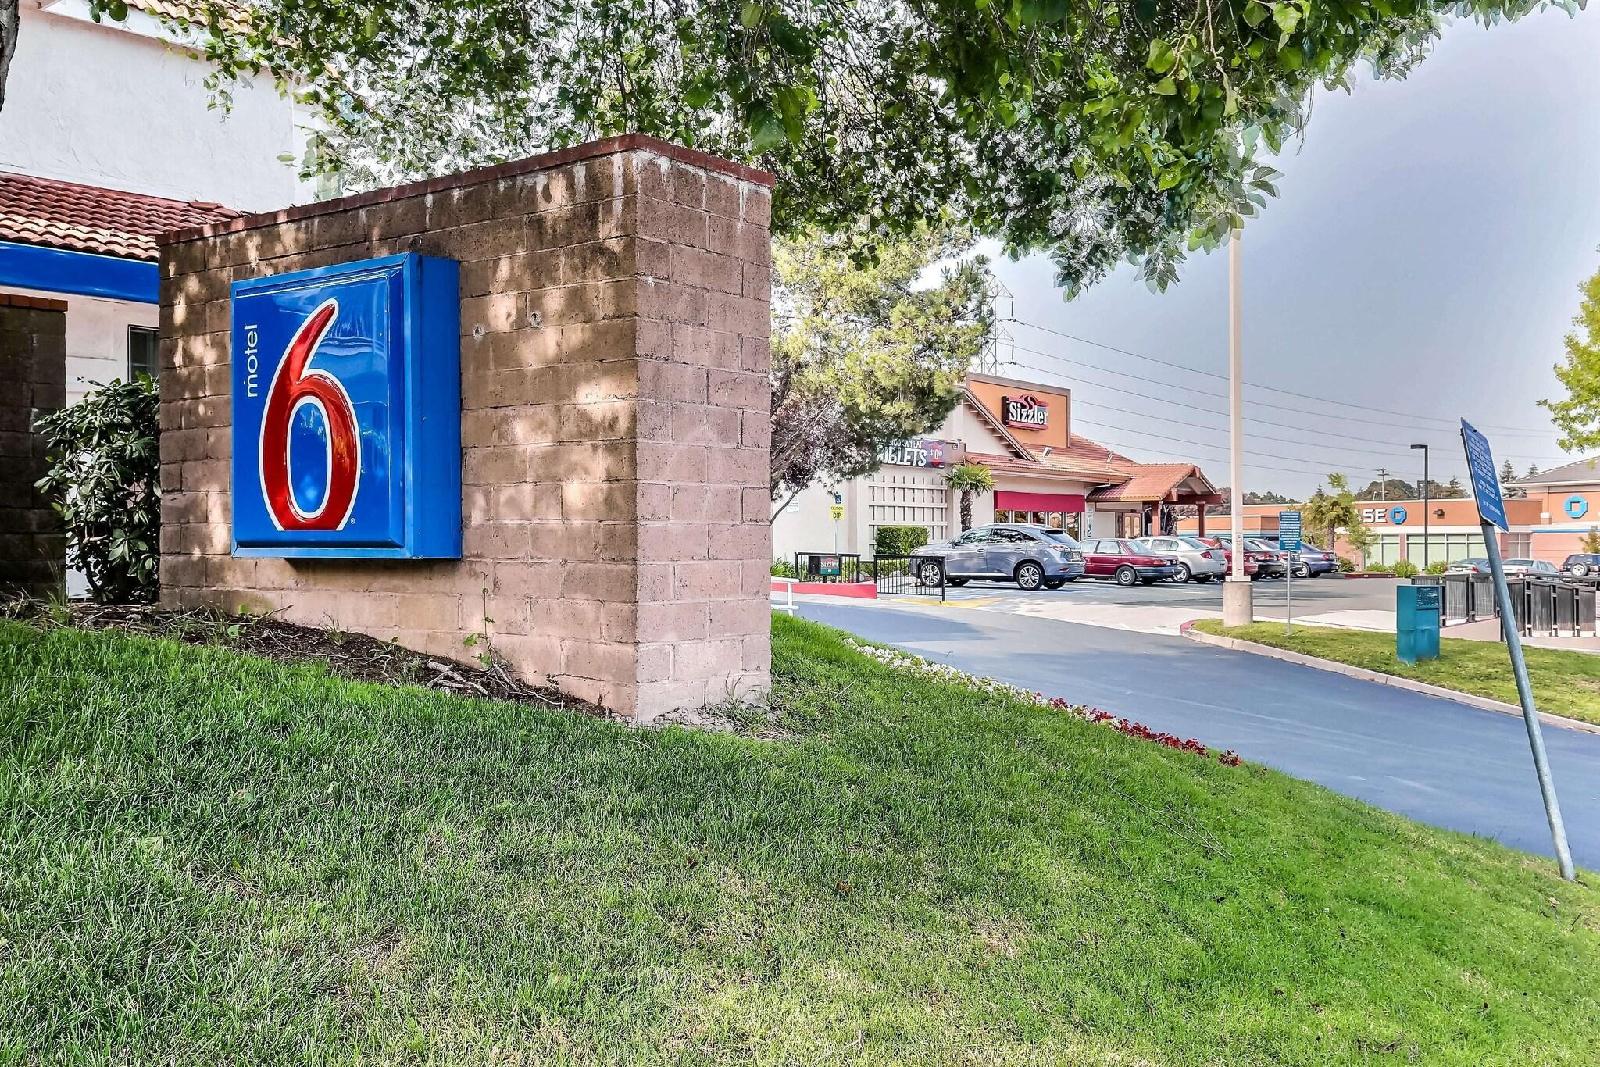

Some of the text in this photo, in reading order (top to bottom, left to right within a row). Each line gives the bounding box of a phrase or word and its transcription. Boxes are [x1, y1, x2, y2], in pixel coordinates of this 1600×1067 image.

[244, 324, 258, 397] motel
[259, 298, 361, 531] 6
[1009, 402, 1048, 425] Sizzler
[1361, 508, 1388, 523] SE
